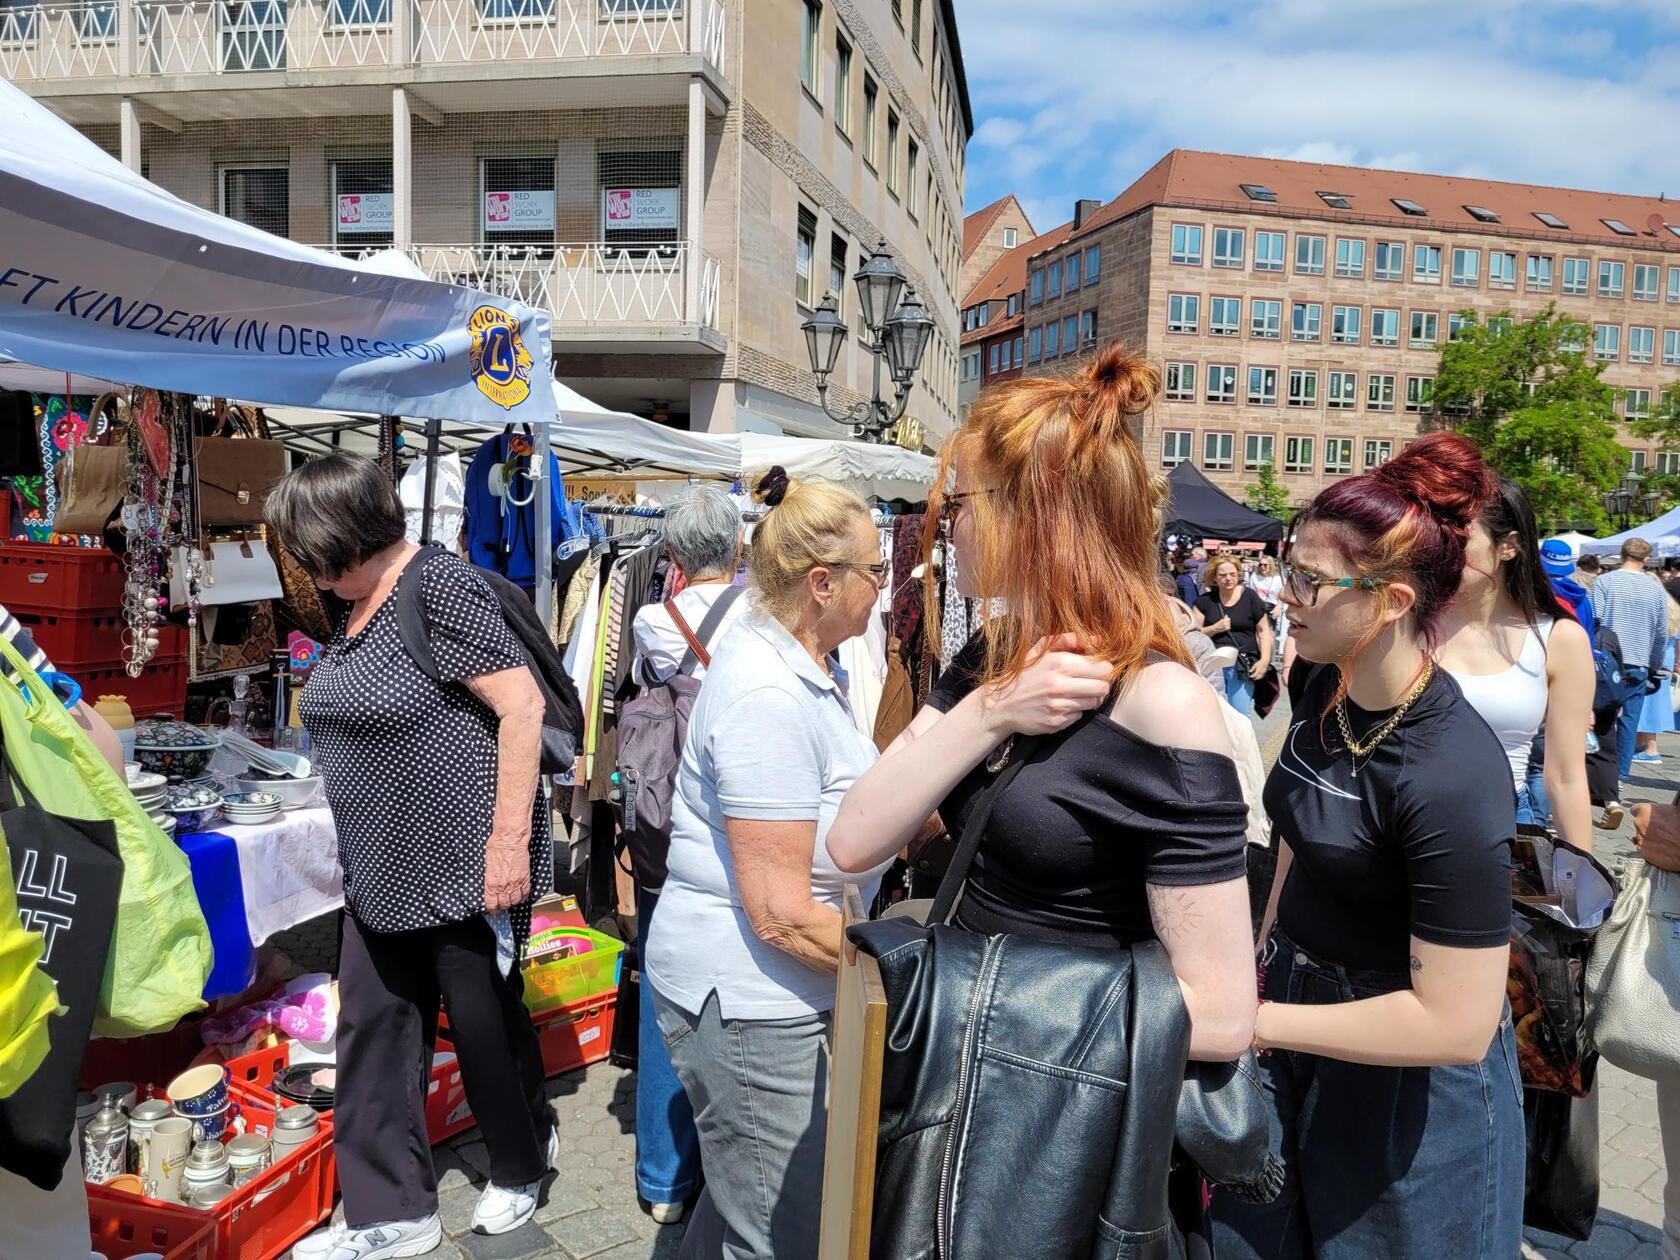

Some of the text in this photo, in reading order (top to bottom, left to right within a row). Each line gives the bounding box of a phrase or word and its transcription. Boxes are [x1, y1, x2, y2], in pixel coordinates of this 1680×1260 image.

[514, 192, 530, 200] RED
[636, 190, 652, 198] RED
[365, 195, 381, 203] RED
[365, 211, 393, 219] GROUP
[514, 208, 543, 217] GROUP
[636, 206, 666, 215] GROUP
[0, 268, 446, 364] FT KINDERN IN DER REGION
[473, 309, 520, 332] LIONS
[490, 333, 510, 372] L
[7, 846, 77, 905] LL
